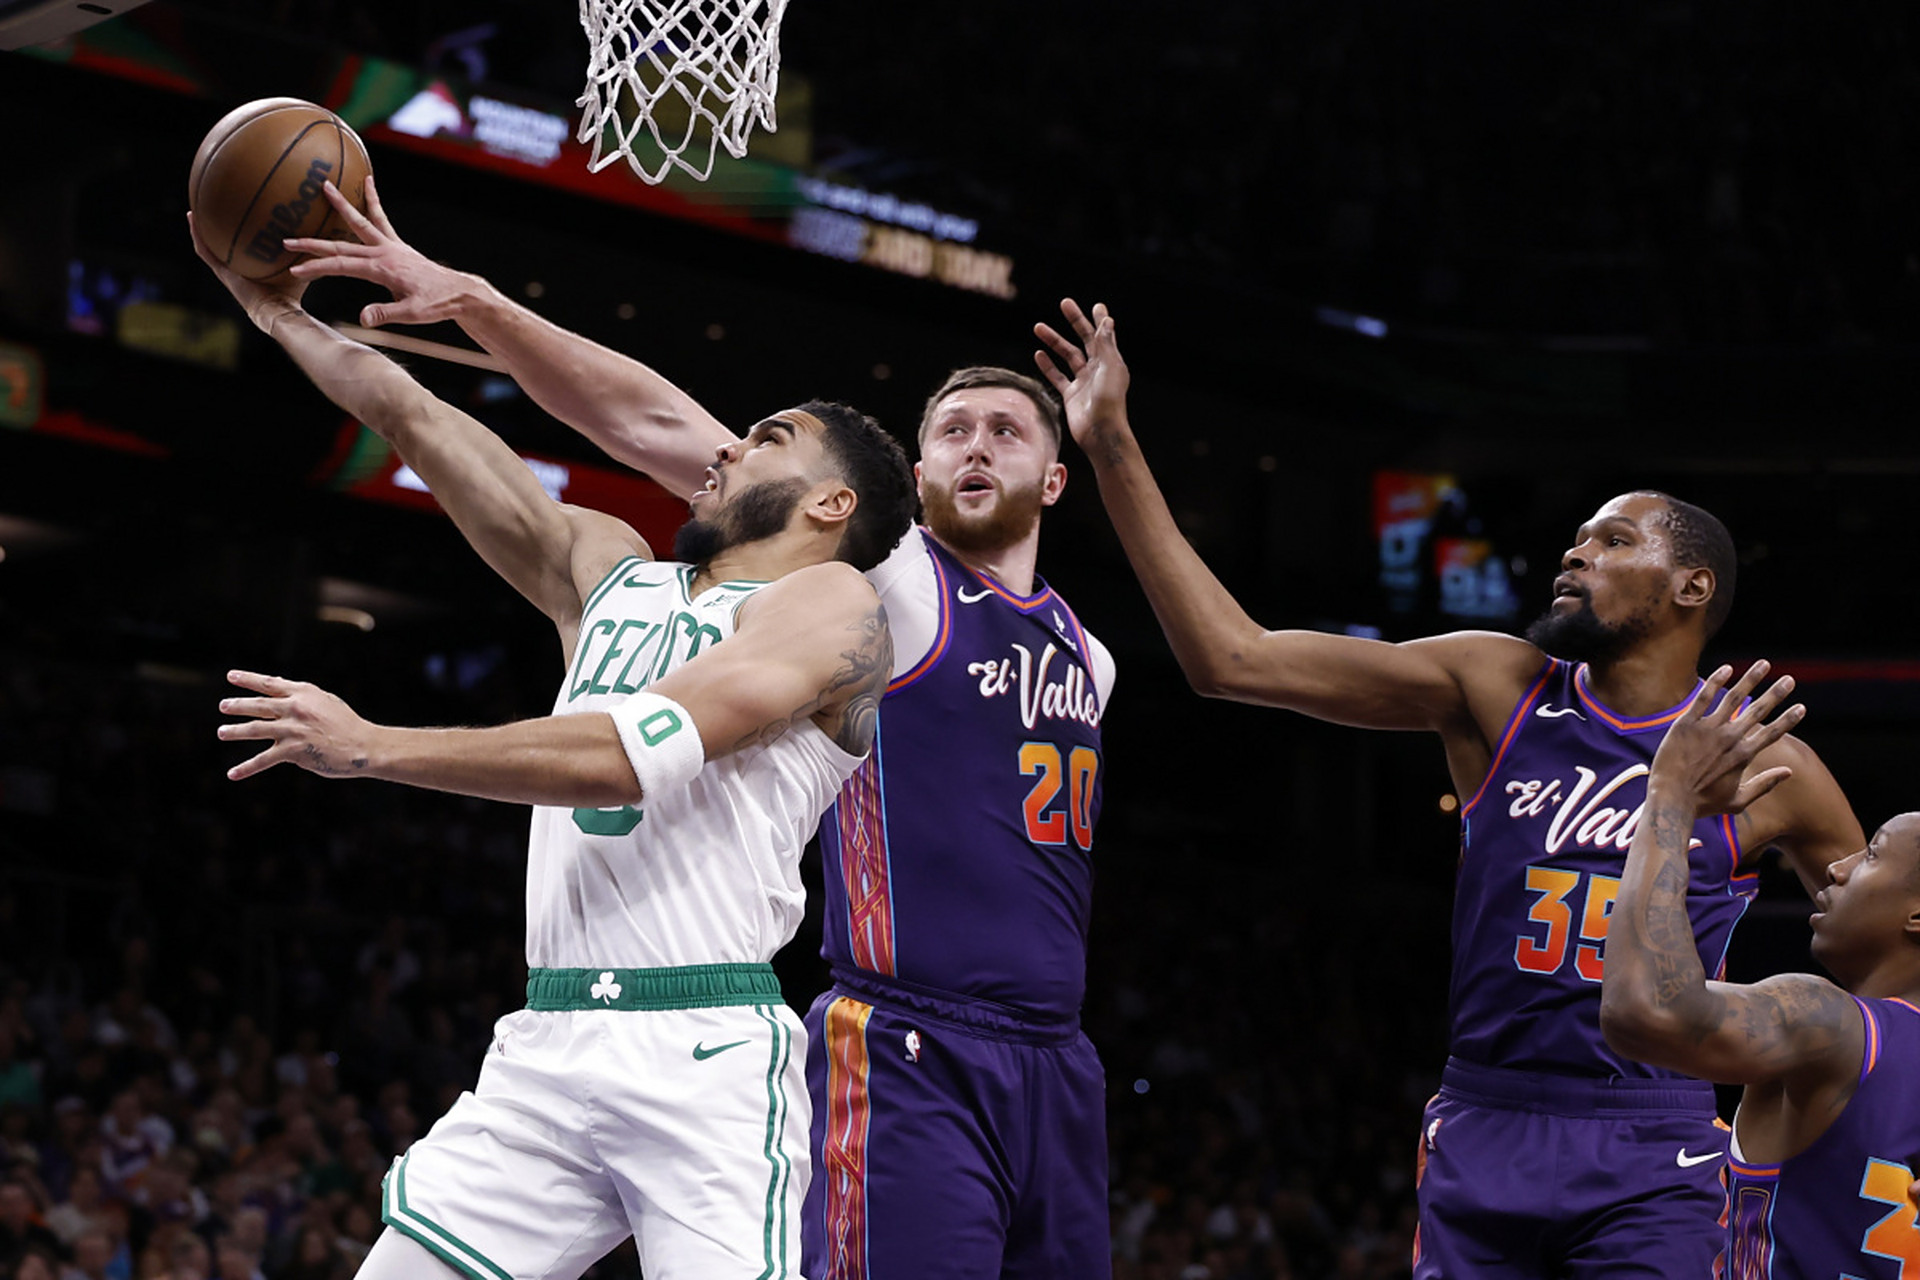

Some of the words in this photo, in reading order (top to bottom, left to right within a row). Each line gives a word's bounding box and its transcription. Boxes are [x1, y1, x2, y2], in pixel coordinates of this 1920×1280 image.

[967, 658, 1011, 698] El
[637, 708, 682, 747] 0
[1018, 741, 1099, 852] 20
[1505, 779, 1561, 818] El
[1514, 865, 1622, 983] 35
